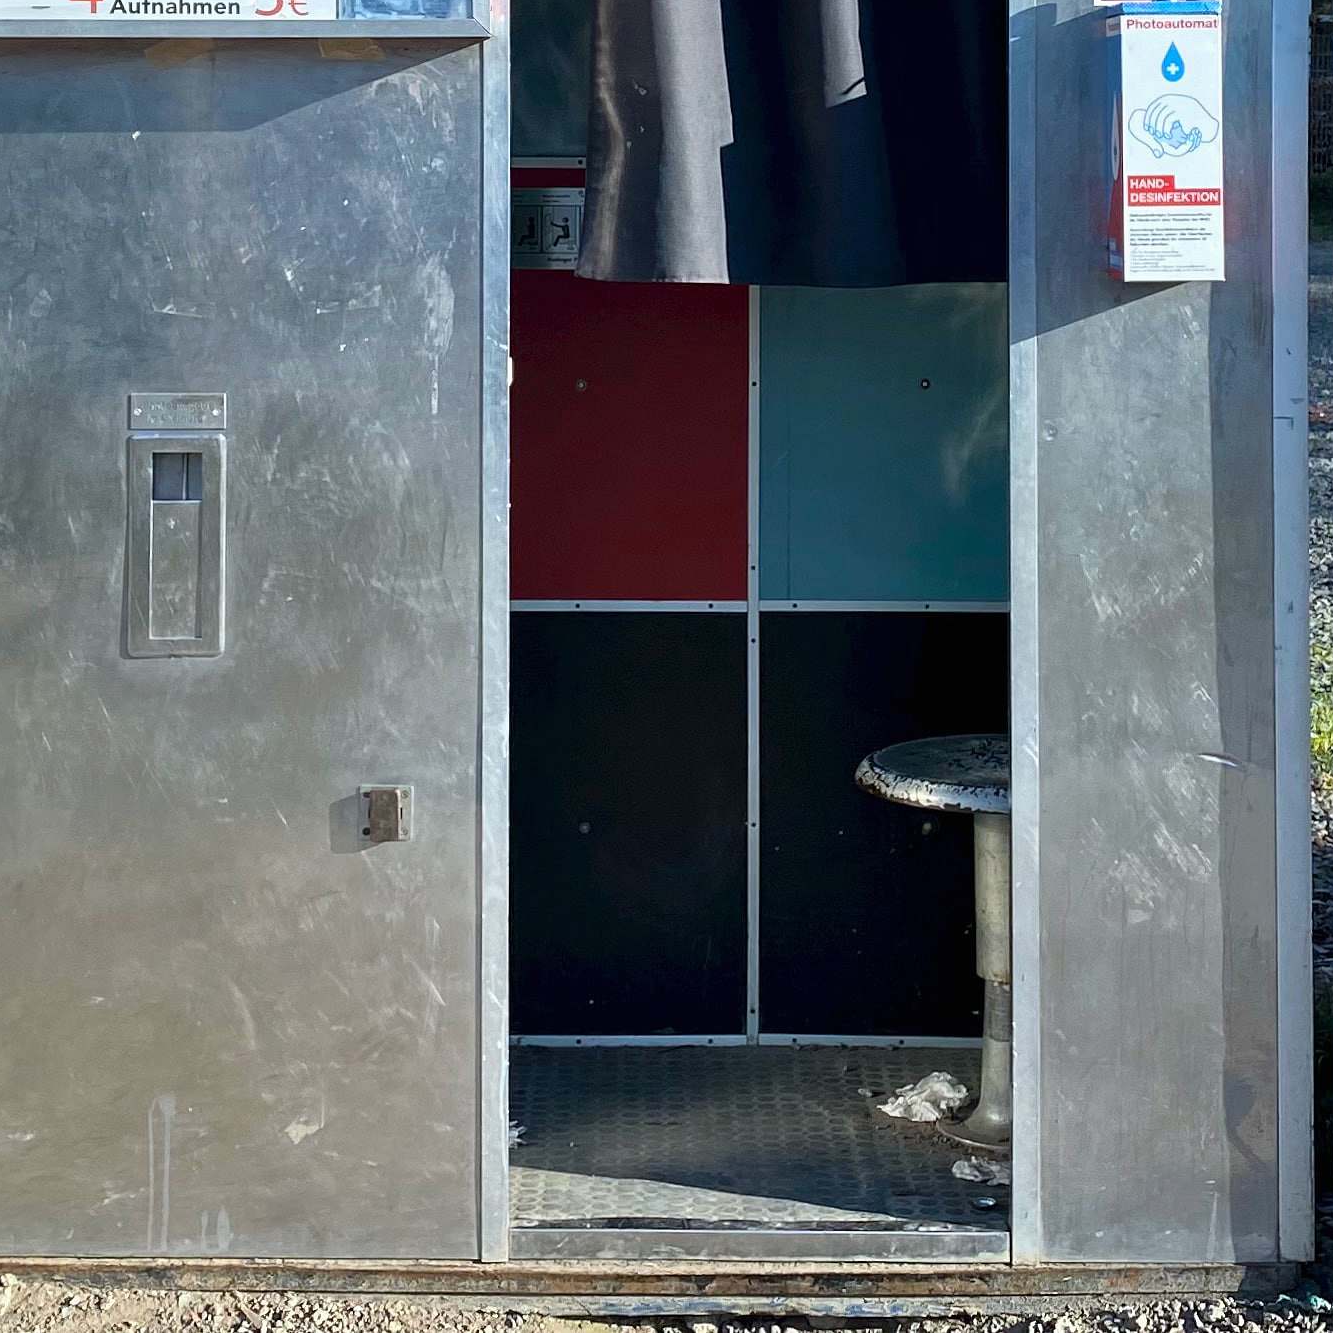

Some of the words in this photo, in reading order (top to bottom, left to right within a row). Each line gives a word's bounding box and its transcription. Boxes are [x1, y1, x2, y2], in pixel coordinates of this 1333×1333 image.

[1126, 19, 1218, 29] Photoautomat
[1130, 178, 1169, 189] HAND-
[1130, 192, 1219, 203] DESINFEKTION
